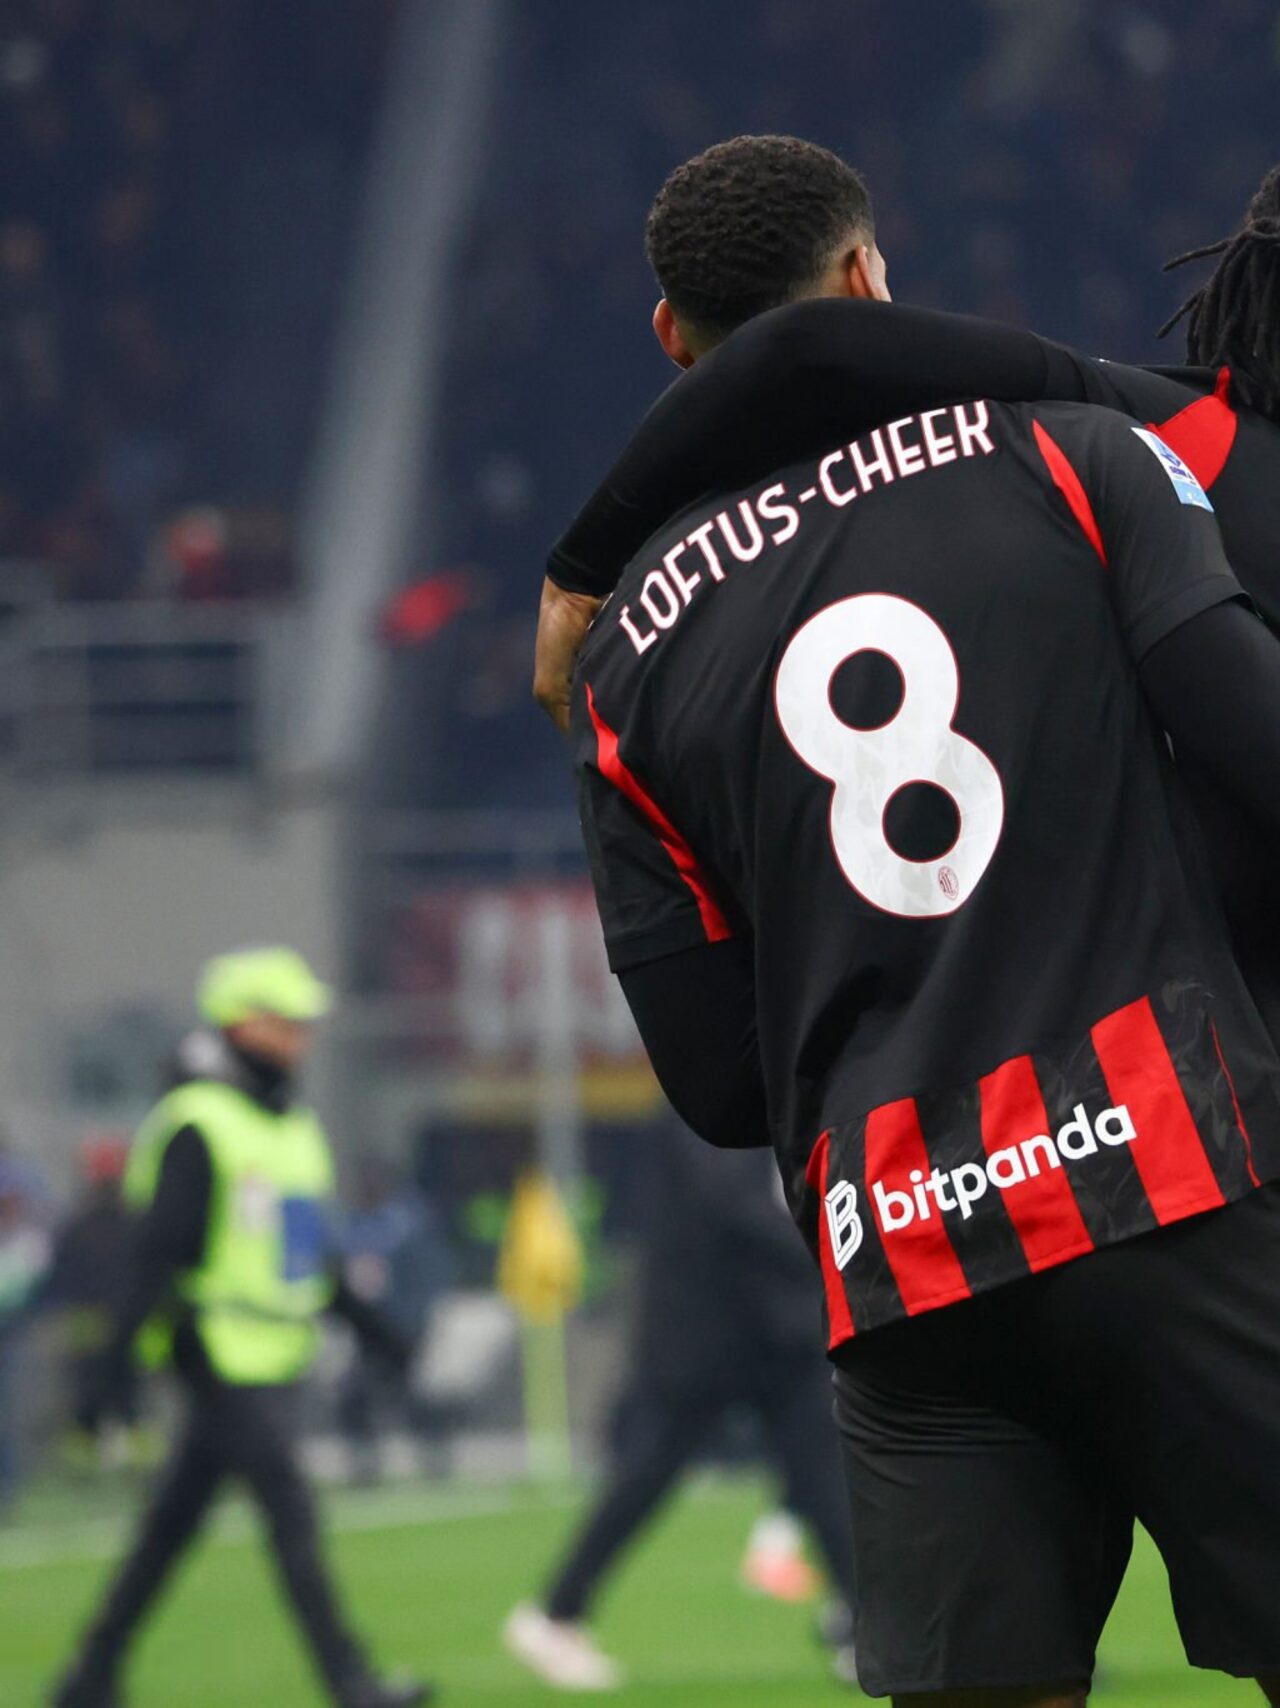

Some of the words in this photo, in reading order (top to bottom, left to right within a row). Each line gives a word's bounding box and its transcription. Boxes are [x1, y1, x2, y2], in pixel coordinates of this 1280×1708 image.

[618, 399, 995, 655] LOFTUS-CHEEK
[773, 591, 1004, 919] 8
[872, 1103, 1137, 1232] bitpanda
